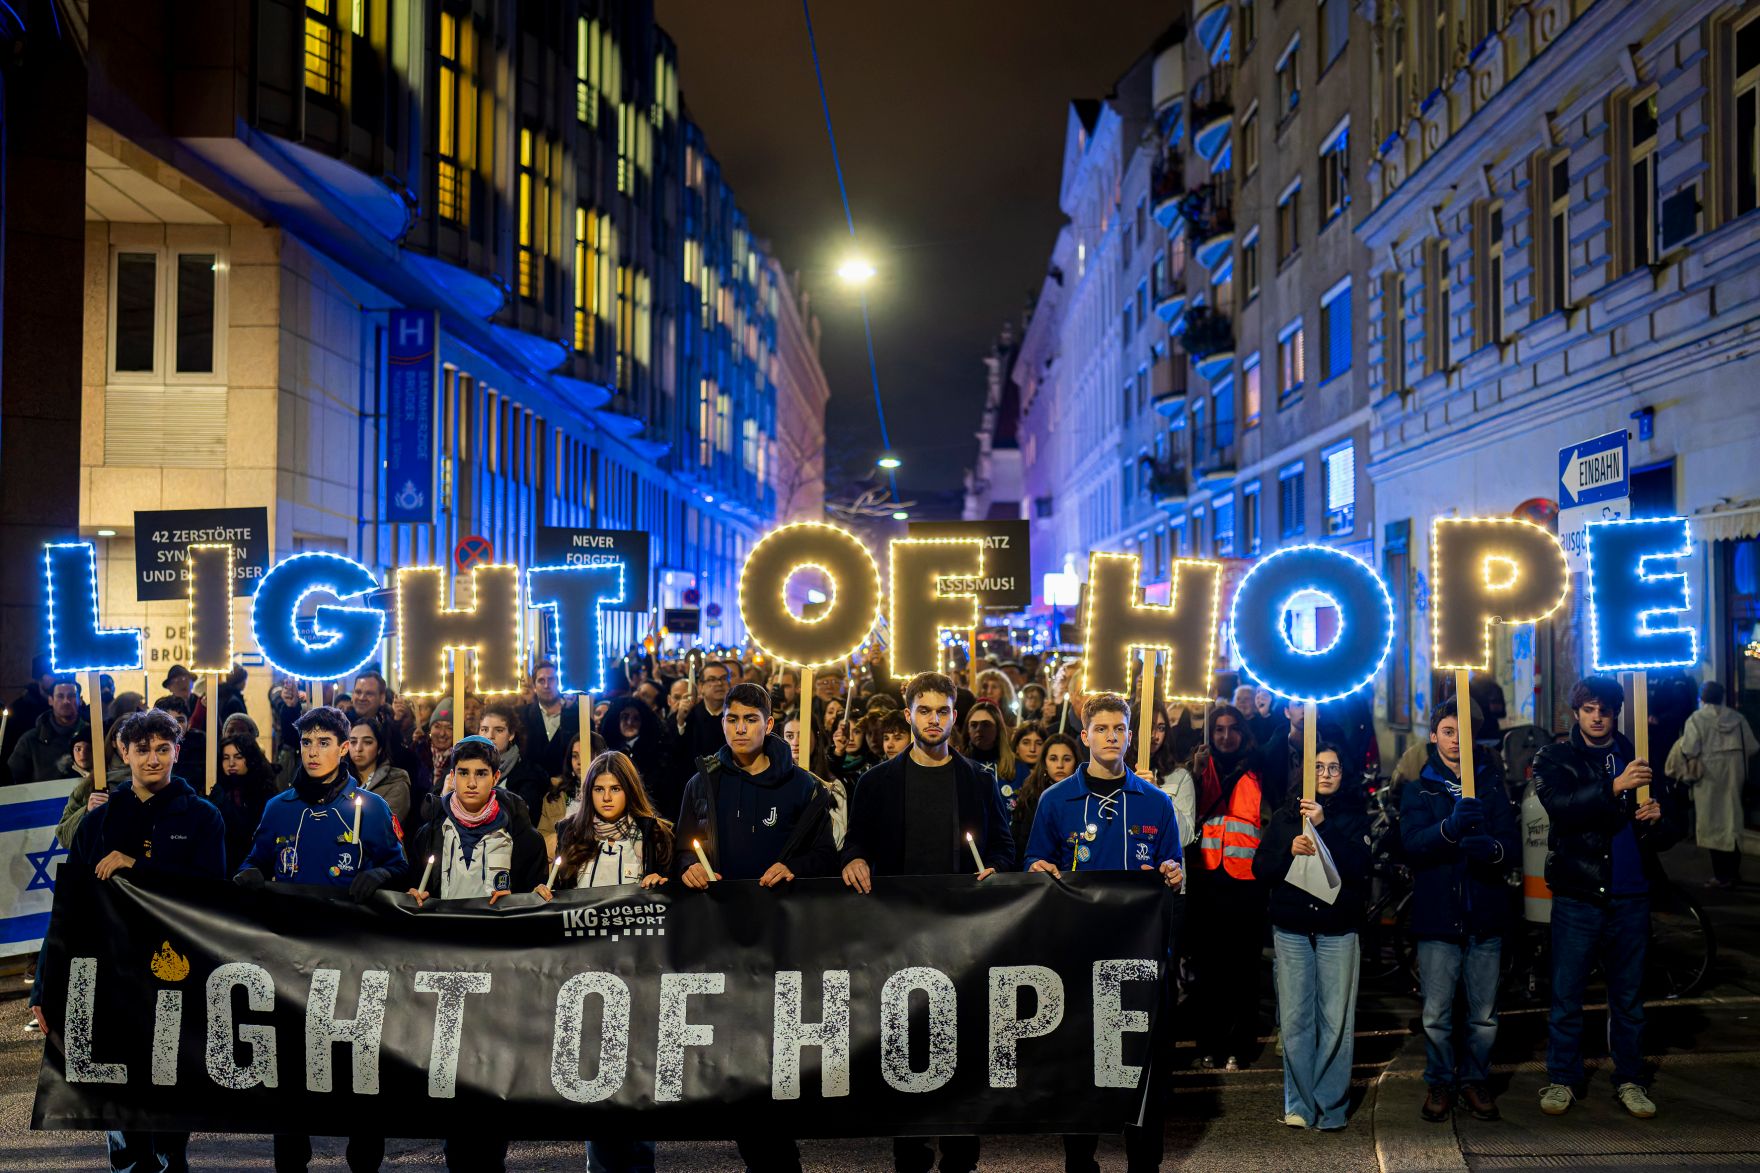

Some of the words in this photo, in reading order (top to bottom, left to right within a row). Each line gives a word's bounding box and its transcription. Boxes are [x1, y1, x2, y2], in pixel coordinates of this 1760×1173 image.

[400, 318, 424, 345] H
[1579, 451, 1620, 487] EINBAHN
[152, 531, 169, 543] 42
[173, 526, 251, 542] ZERSTÖRTE
[573, 535, 614, 548] NEVER
[983, 536, 1010, 549] ATZ
[157, 547, 247, 562] SYNEN
[566, 553, 620, 565] FORGET!
[143, 569, 176, 583] UND
[939, 576, 1015, 592] ASSISMUS!
[42, 540, 626, 698] LIGHT
[738, 520, 985, 681] OF
[1081, 516, 1700, 704] HOPE
[165, 626, 188, 639] DE
[600, 904, 667, 917] JUGEND
[563, 908, 598, 929] IKG
[550, 970, 726, 1104] OF
[771, 958, 1160, 1101] HOPE
